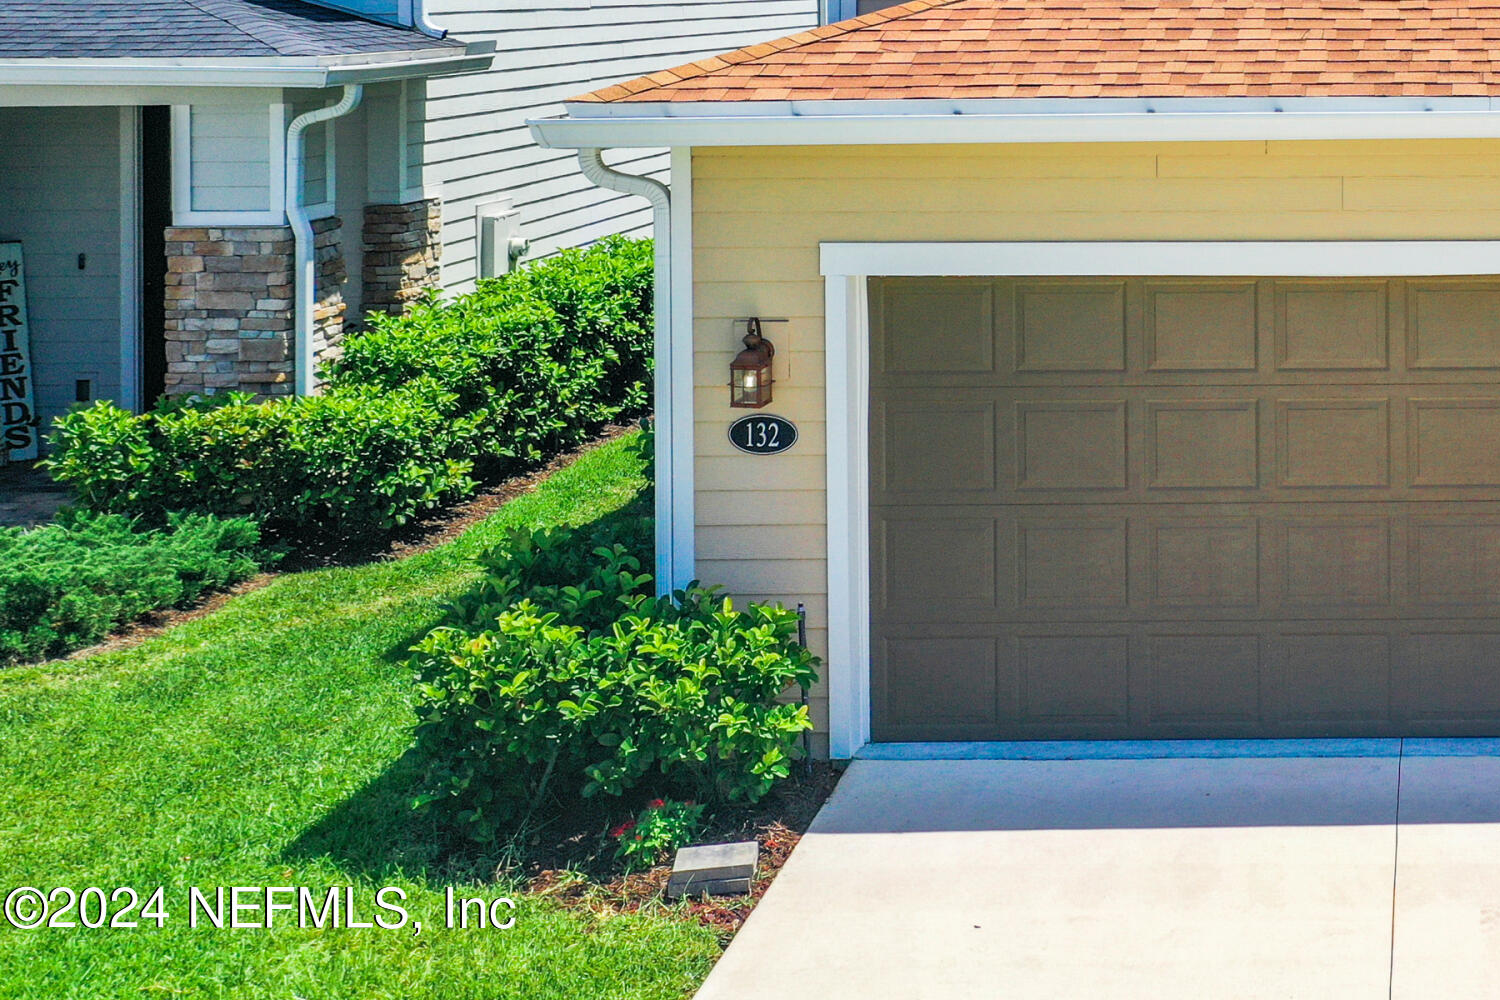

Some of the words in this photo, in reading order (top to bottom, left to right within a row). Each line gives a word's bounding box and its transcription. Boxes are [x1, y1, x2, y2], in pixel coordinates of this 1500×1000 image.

[0, 260, 21, 277] ey
[0, 280, 32, 449] FRIENDS
[745, 422, 780, 448] 132
